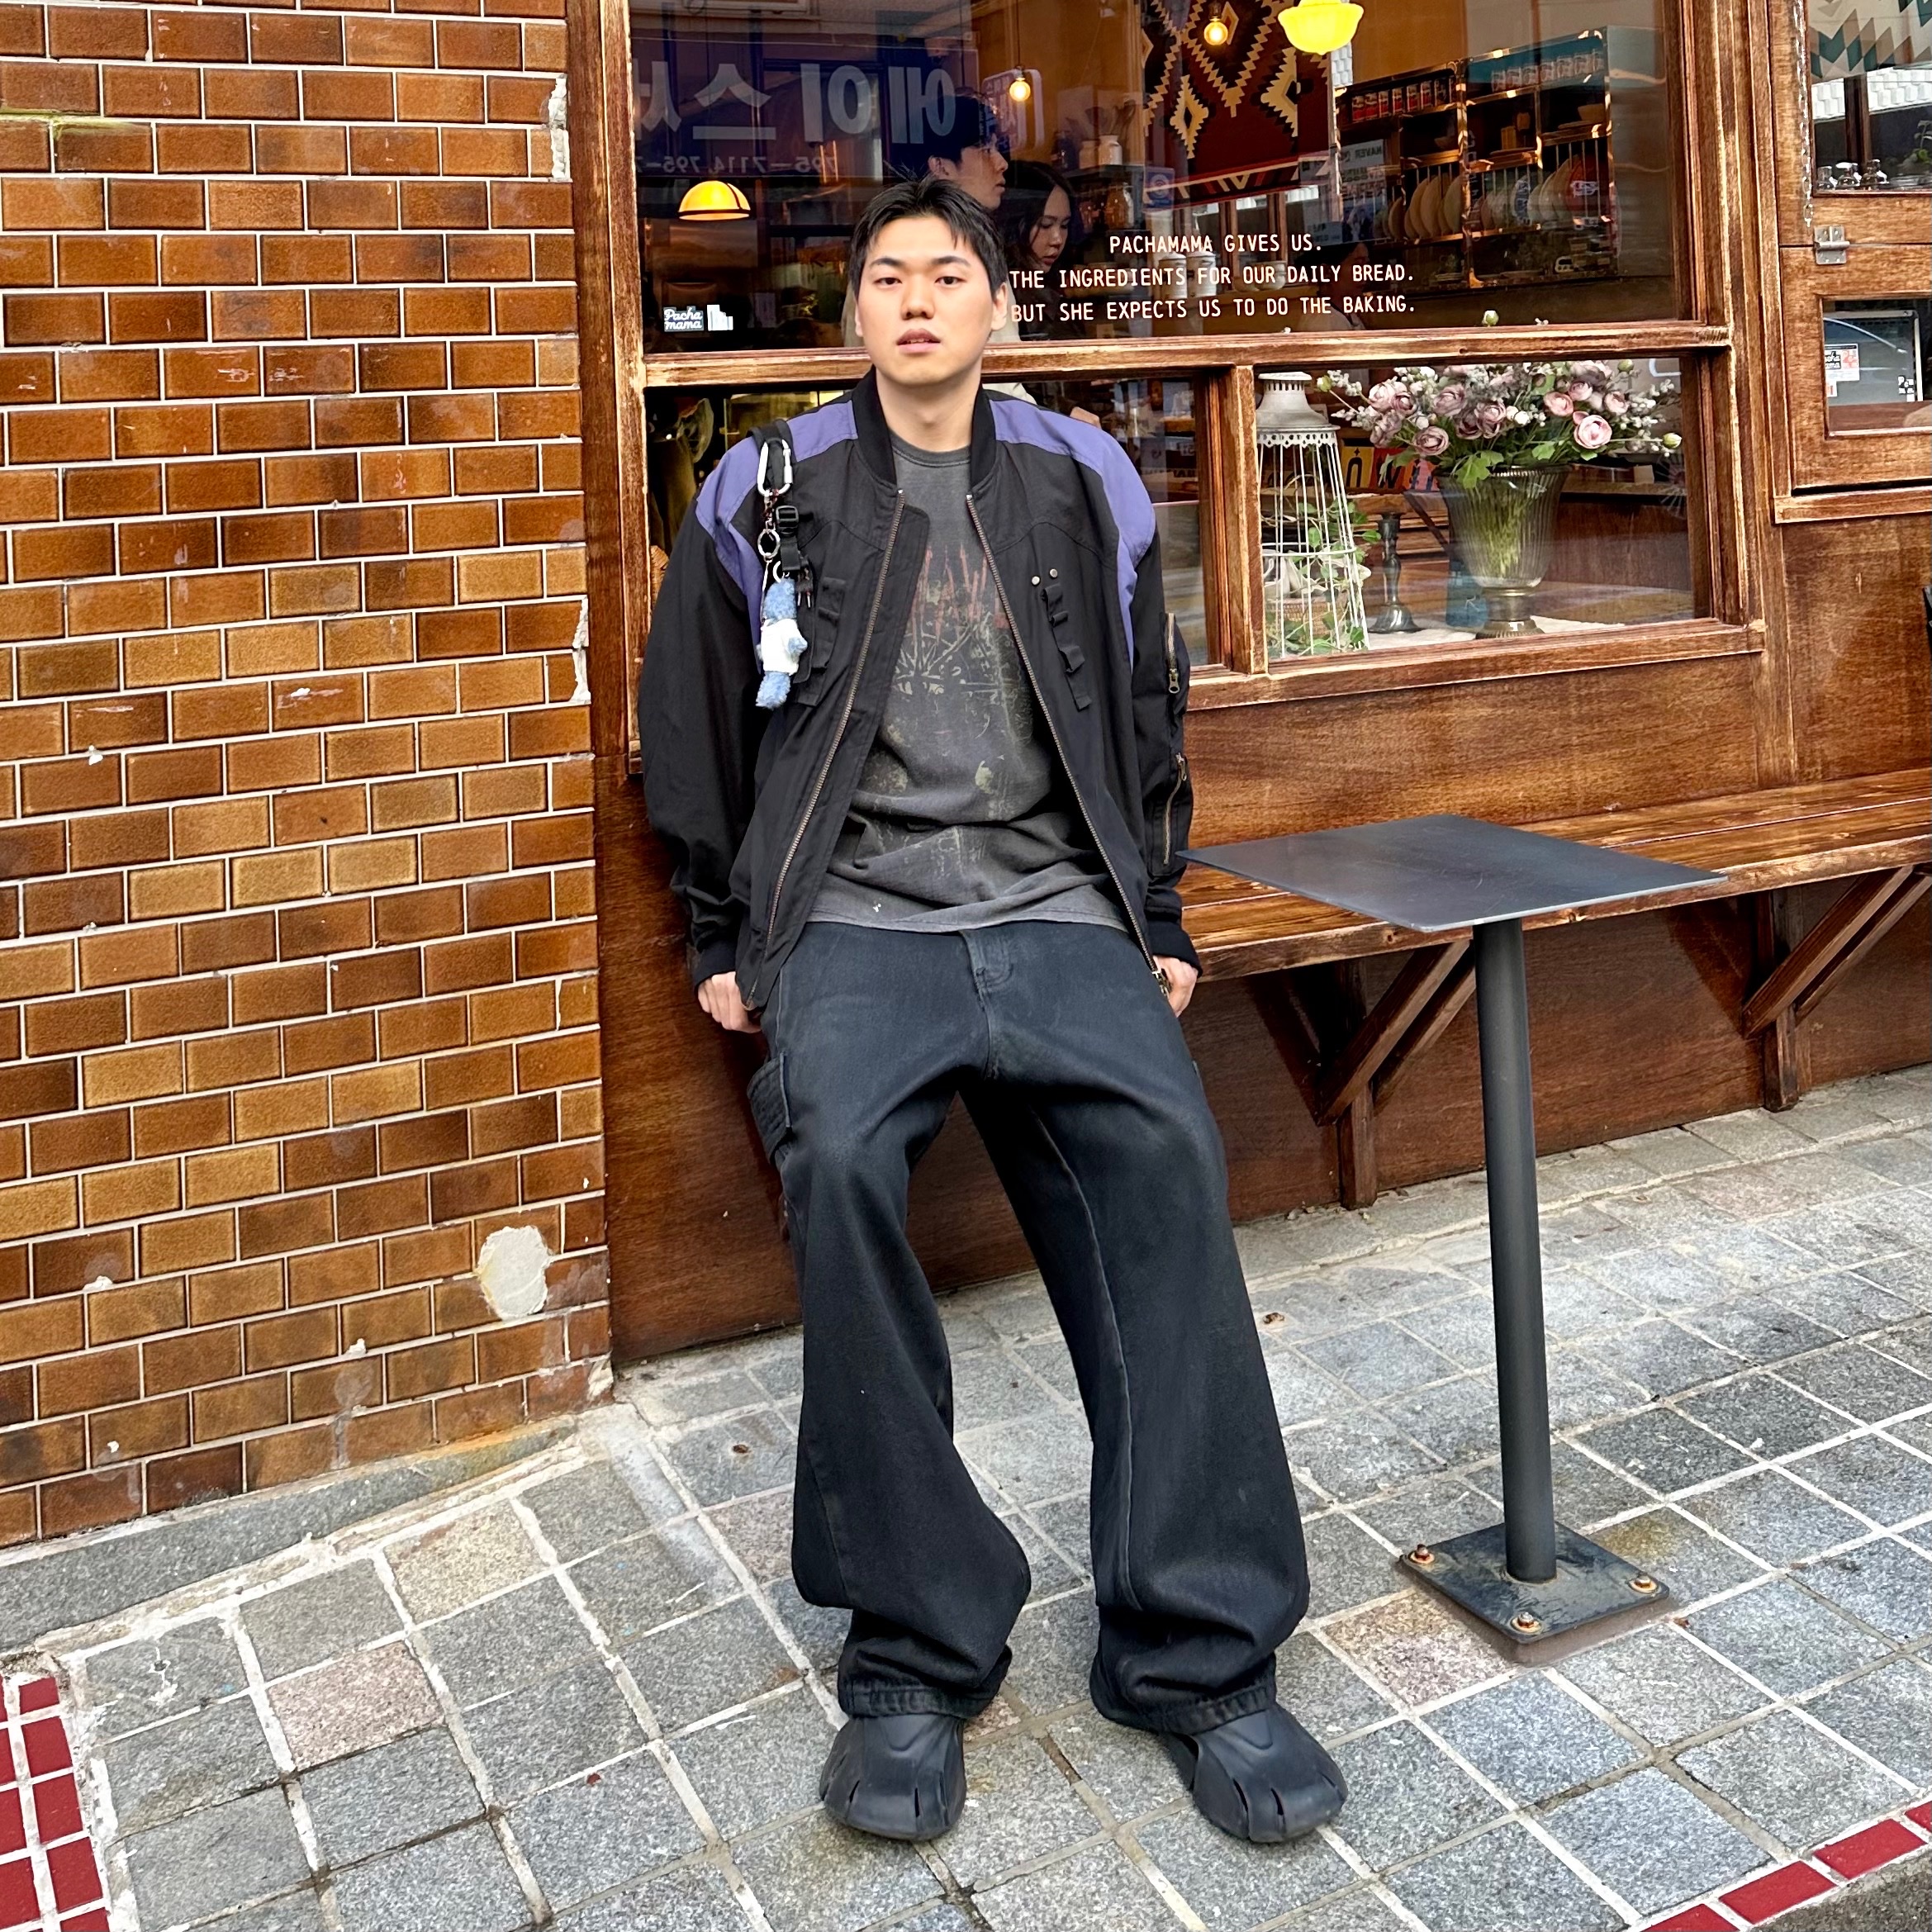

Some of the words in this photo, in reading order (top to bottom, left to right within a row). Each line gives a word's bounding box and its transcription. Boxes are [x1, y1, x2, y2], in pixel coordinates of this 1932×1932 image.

[1109, 235, 1213, 254] PACHAMAMA
[1224, 233, 1279, 253] GIVES
[1291, 233, 1322, 251] US.
[1009, 270, 1045, 288] THE
[1059, 266, 1187, 288] INGREDIENTS
[1198, 266, 1232, 285] FOR
[1243, 266, 1276, 284] OUR
[1287, 264, 1341, 283] DAILY
[1352, 263, 1414, 282] BREAD.
[664, 307, 702, 320] Pacha
[1011, 303, 1046, 323] BUT
[1060, 302, 1094, 321] SHE
[1107, 300, 1188, 320] EXPECTS
[1199, 299, 1222, 318] US
[1233, 297, 1255, 316] TO
[1266, 297, 1289, 316] DO
[1299, 296, 1332, 314] THE
[1343, 294, 1414, 313] BAKING.
[664, 320, 702, 330] mama
